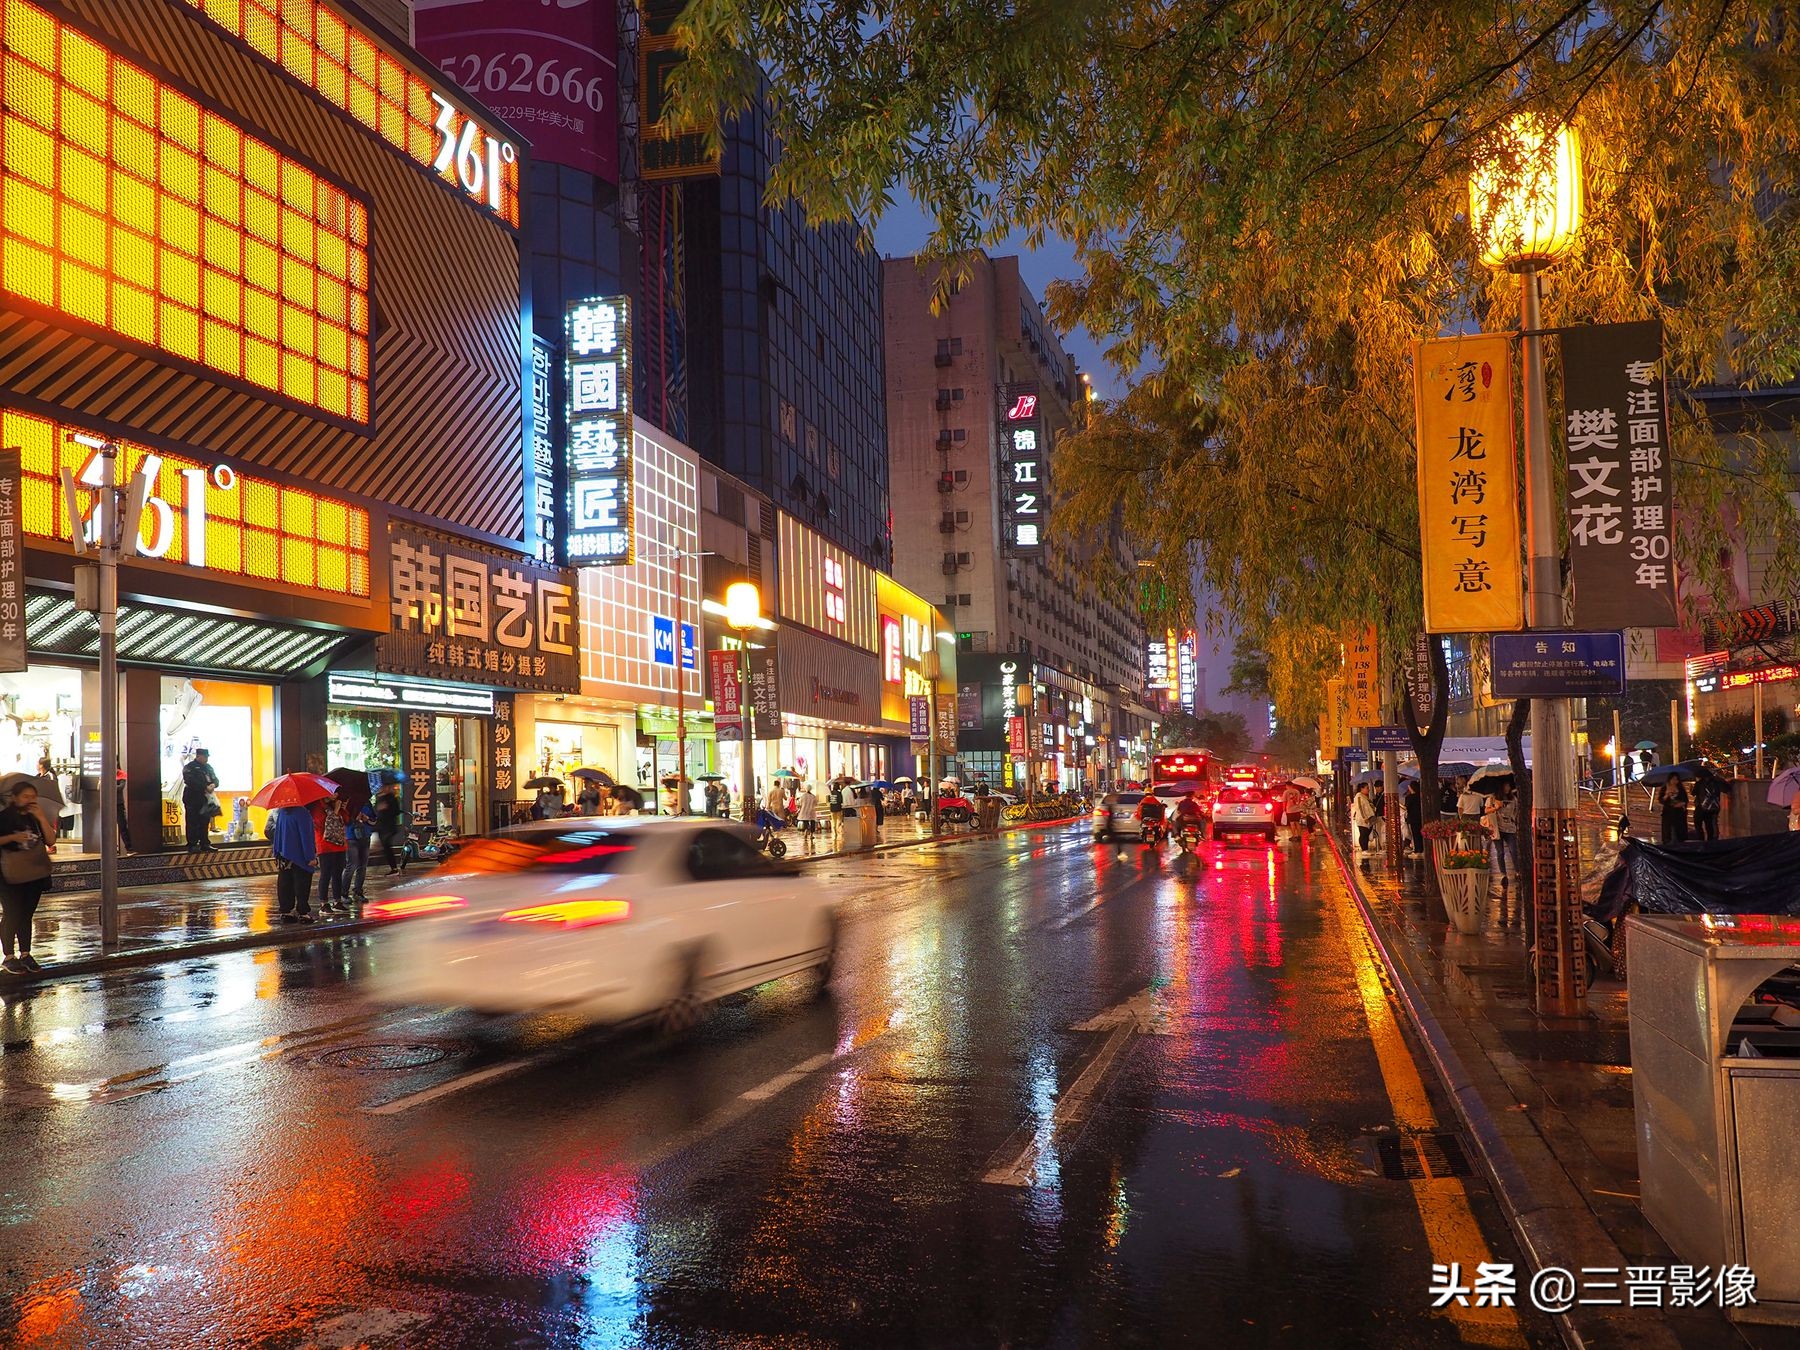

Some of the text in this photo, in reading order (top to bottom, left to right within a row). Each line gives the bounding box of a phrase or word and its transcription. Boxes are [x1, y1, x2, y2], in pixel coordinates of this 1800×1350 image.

[431, 91, 515, 211] 361°
[571, 304, 618, 530] 韓國藝匠
[1625, 360, 1670, 590] 专注面部护理30年
[1013, 429, 1038, 545] 锦江之星
[1448, 426, 1491, 594] 龙湾写意
[1568, 407, 1624, 546] 樊文花
[391, 539, 573, 656] 韩国艺匠
[655, 629, 672, 652] KM
[1535, 641, 1576, 654] 告知
[427, 642, 546, 677] 纯韩式婚纱摄影
[752, 672, 768, 714] 樊文花
[409, 712, 432, 827] 韩国艺匠
[494, 700, 512, 790] 婚纱摄影
